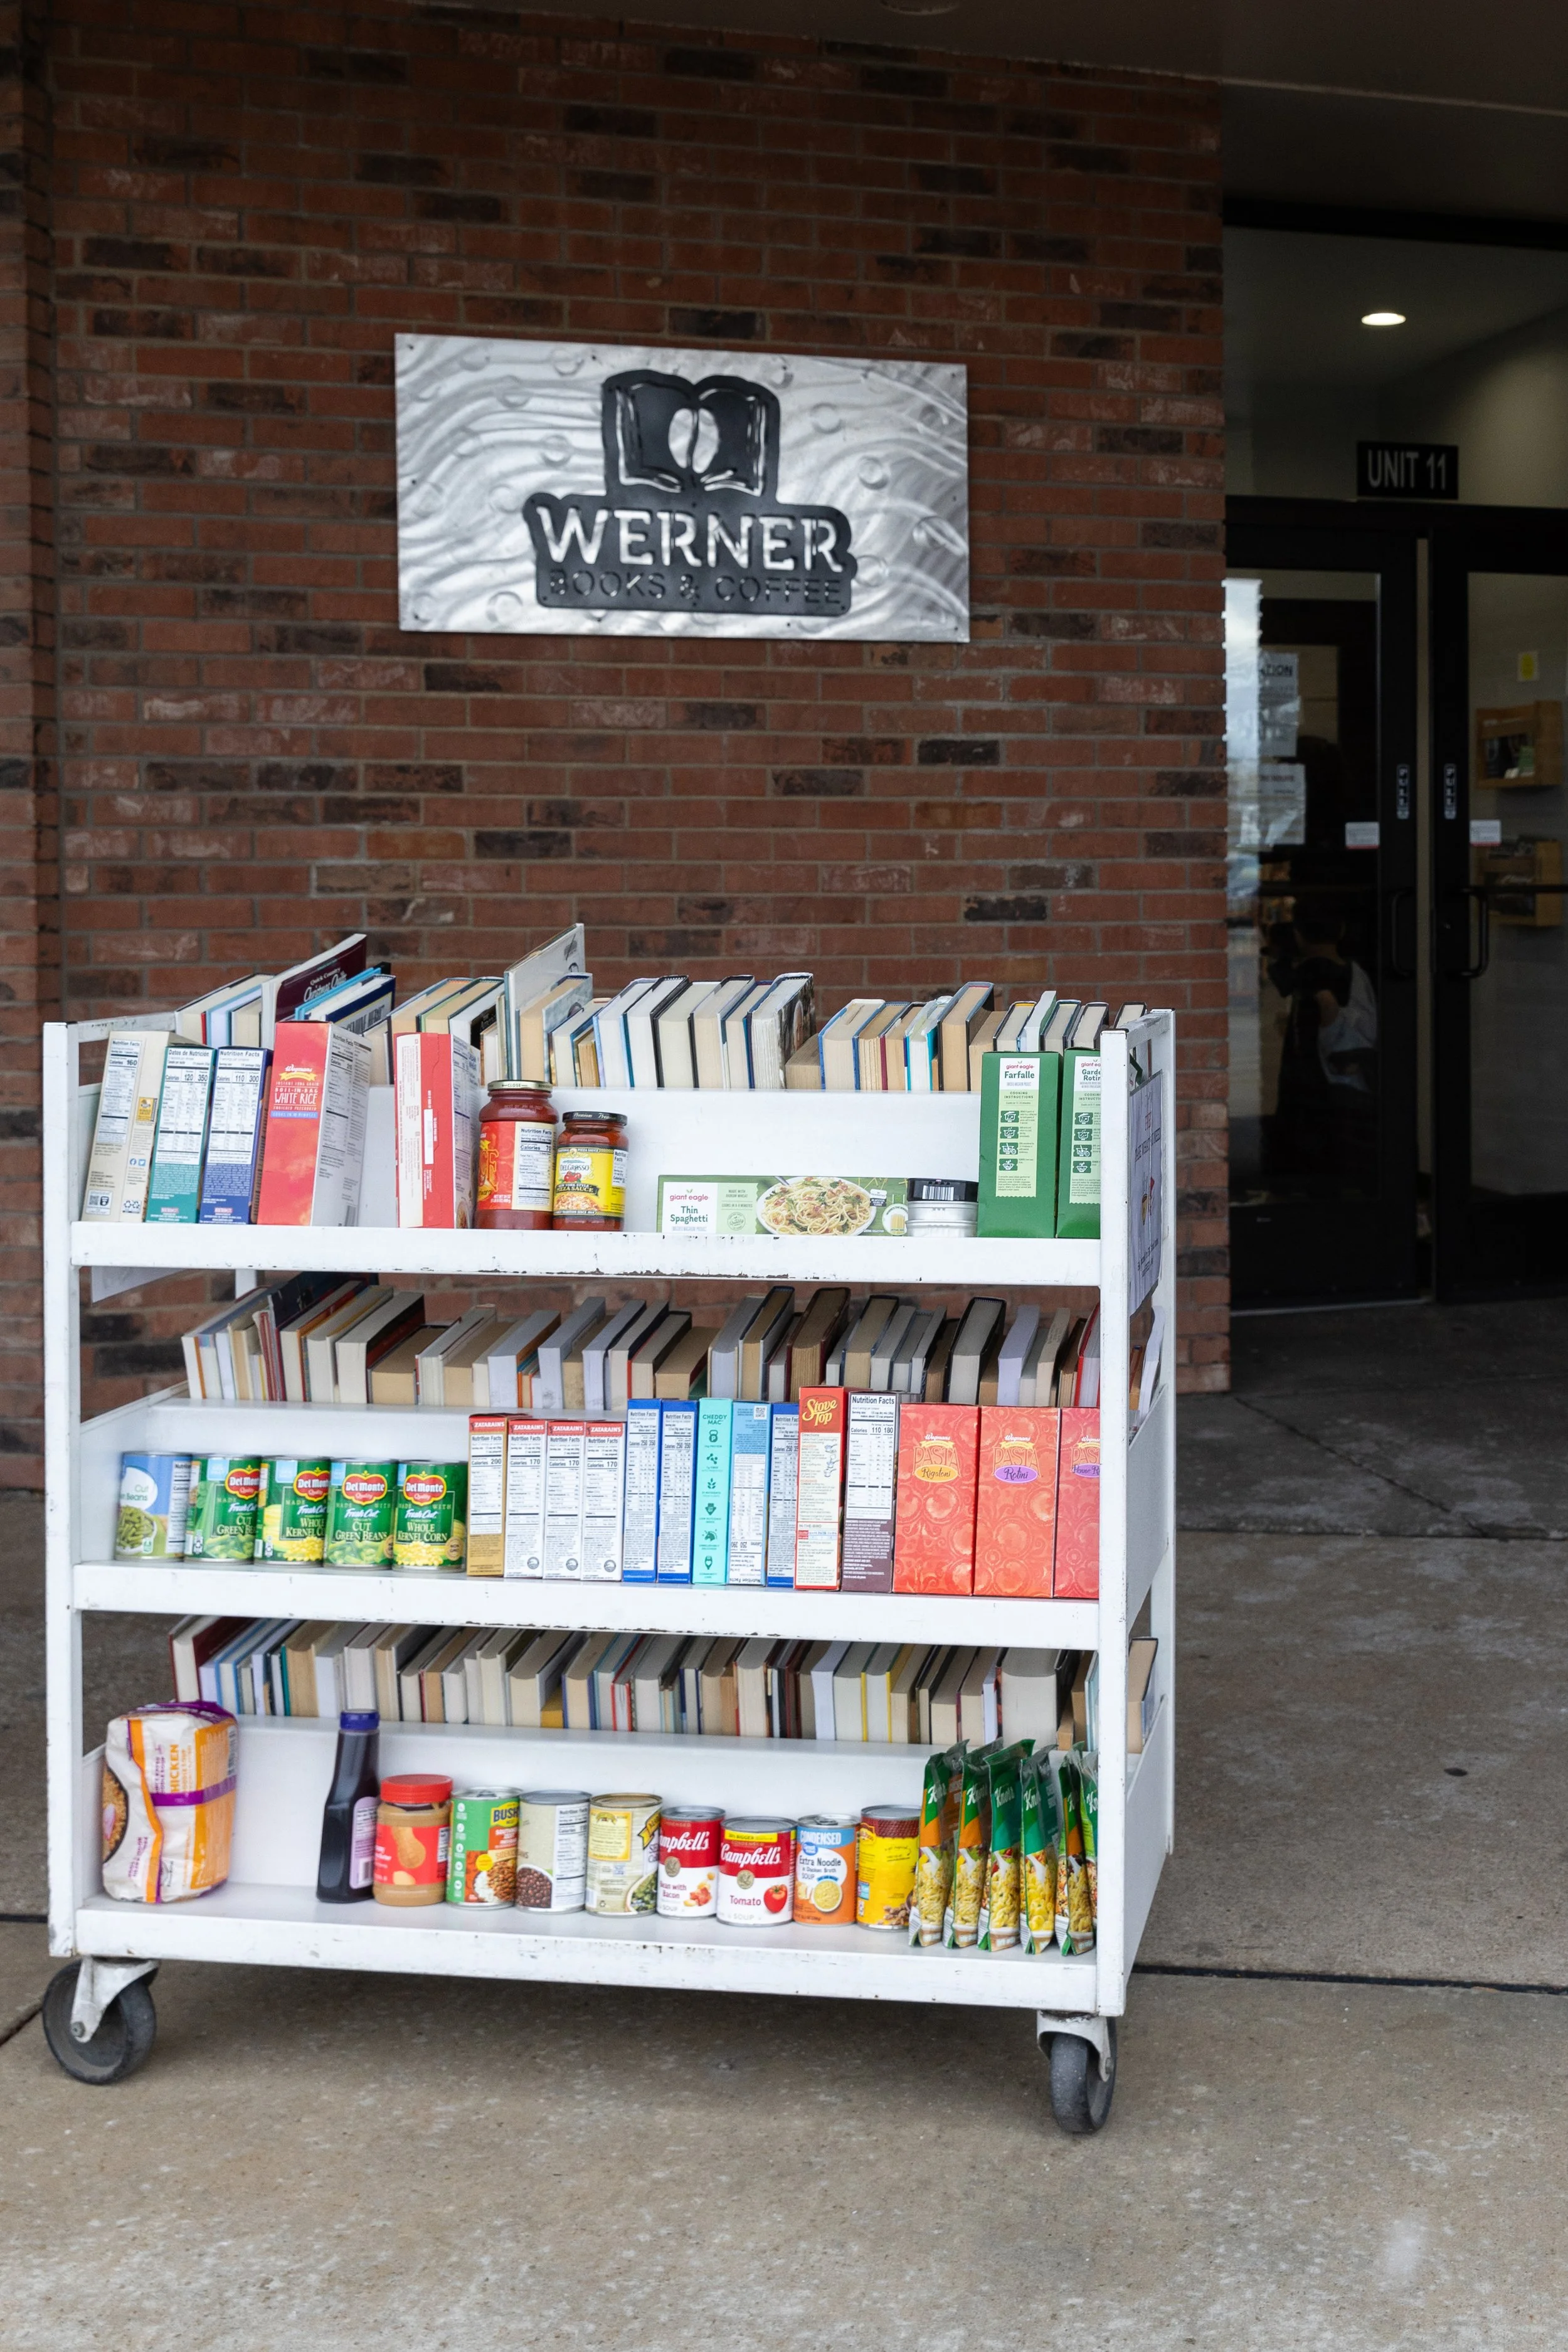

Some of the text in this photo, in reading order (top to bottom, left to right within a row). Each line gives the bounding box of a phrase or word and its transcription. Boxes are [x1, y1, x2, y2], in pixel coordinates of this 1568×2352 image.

[1367, 450, 1446, 489] UNIT 11
[535, 506, 844, 573] WERNER
[549, 568, 841, 605] BOOKS & COFFEE
[1004, 1071, 1035, 1079] Farfalle
[274, 1093, 318, 1104] WHITE RICE
[681, 1205, 698, 1214] Thin
[670, 1214, 708, 1224] Spaghetti
[802, 1399, 838, 1421] Stove
[814, 1411, 833, 1426] Top
[924, 1433, 951, 1441] Wegmans
[1005, 1433, 1030, 1442] Wegmans
[912, 1446, 961, 1477] PASTA
[992, 1446, 1041, 1478] PASTA
[921, 1467, 951, 1480] Rigatoni
[1004, 1466, 1029, 1481] Rotini
[1072, 1465, 1091, 1474] Penne
[230, 1477, 242, 1486] Del
[298, 1479, 311, 1488] Del
[346, 1481, 384, 1491] Del Monte
[134, 1484, 149, 1493] Cut
[406, 1483, 443, 1493] Del Monte
[126, 1492, 147, 1501] Beans
[344, 1508, 364, 1518] Fresh
[405, 1508, 422, 1518] Fresh
[236, 1515, 252, 1525] CUT
[216, 1524, 244, 1535] GREEN
[352, 1522, 371, 1531] CUT
[407, 1522, 435, 1532] WHOLE
[286, 1527, 315, 1537] KERNEL
[336, 1530, 387, 1540] GREEN BEANS
[398, 1530, 447, 1542] KERNEL CORN
[170, 1744, 179, 1793] HICKEN
[800, 1830, 842, 1845] CONDENSED
[721, 1843, 781, 1868] Campbell's
[799, 1855, 842, 1867] Extra Noodle
[663, 1890, 680, 1899] Bacon
[730, 1895, 761, 1905] Tomato
